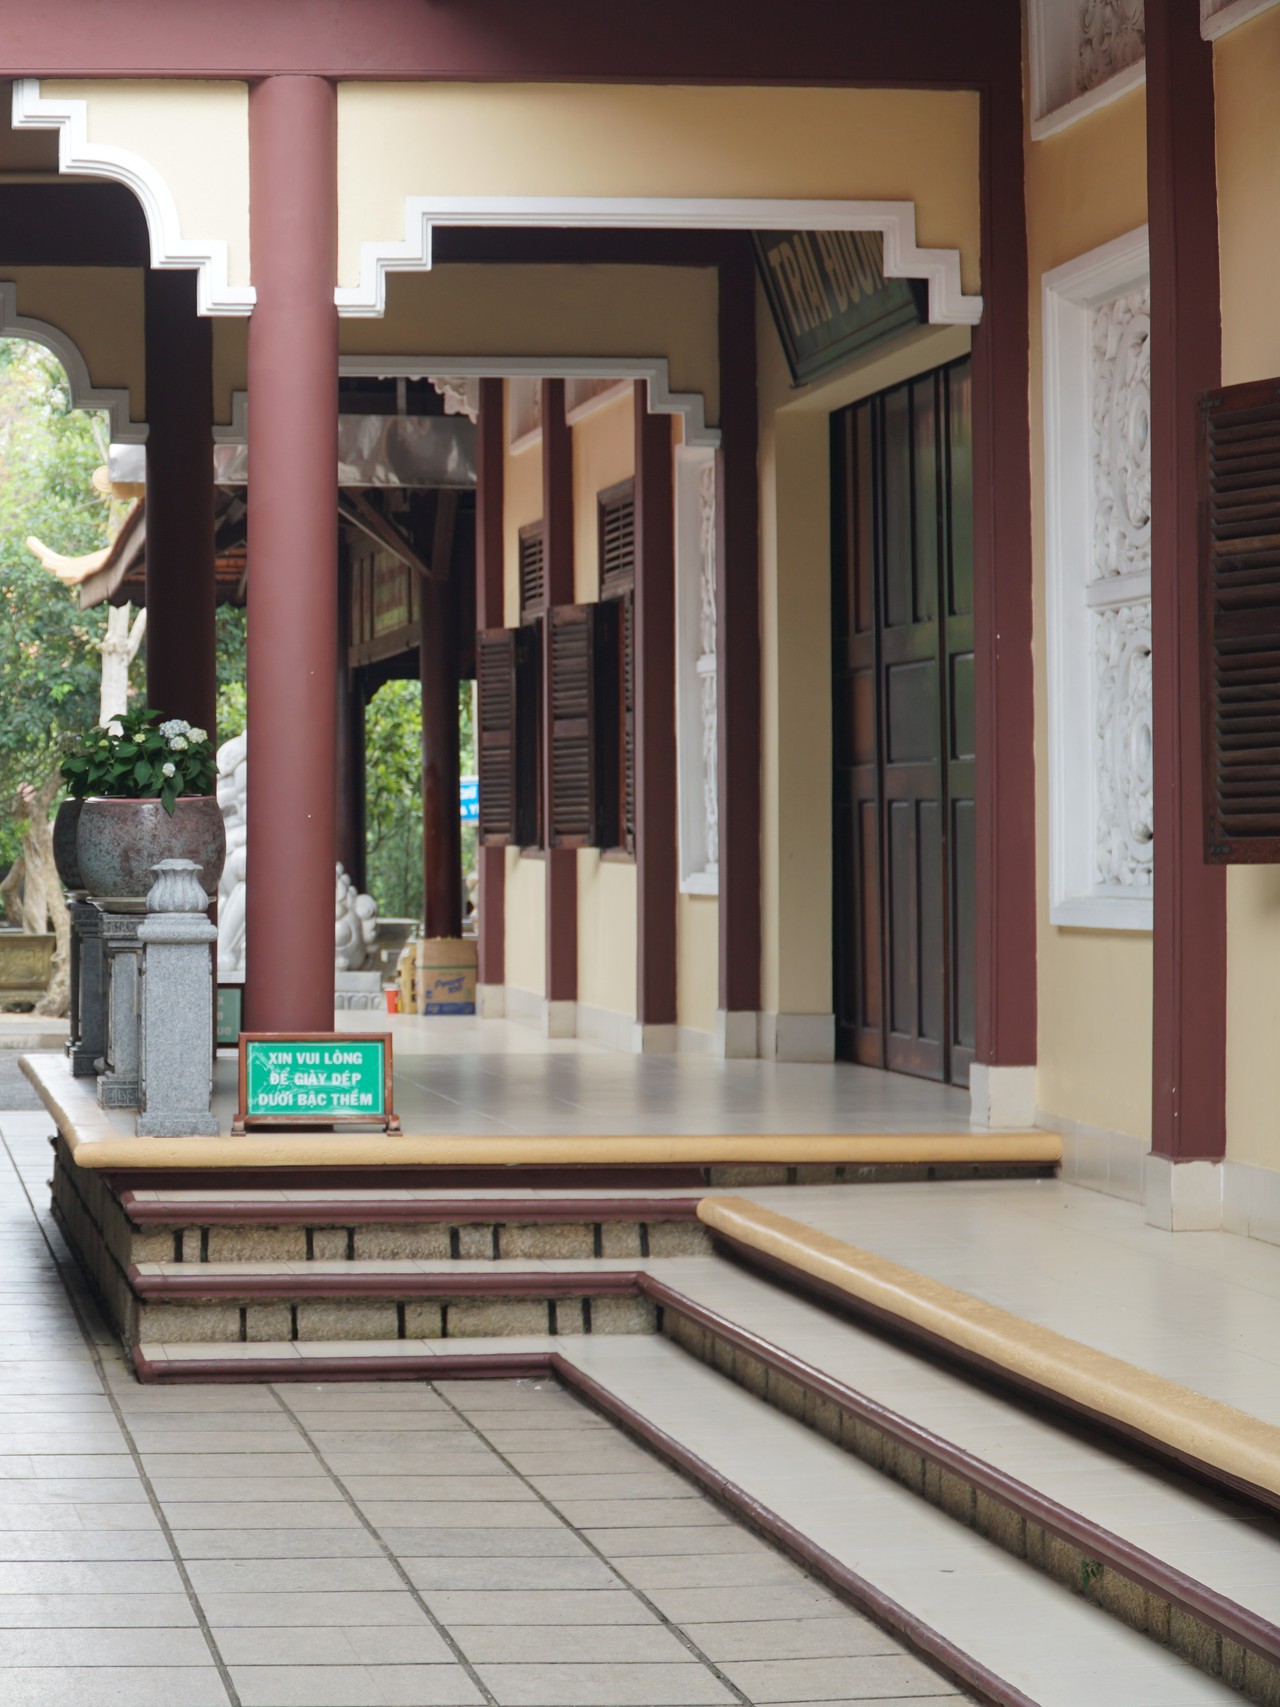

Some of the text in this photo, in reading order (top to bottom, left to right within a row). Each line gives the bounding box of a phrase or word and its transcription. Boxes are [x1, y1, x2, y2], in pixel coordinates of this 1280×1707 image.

[268, 1049, 363, 1065] XIN VUI LÒNG
[270, 1067, 362, 1086] ĐỂ GIÀY DÉP
[258, 1088, 372, 1108] DƯỚI BẬC THỀM
